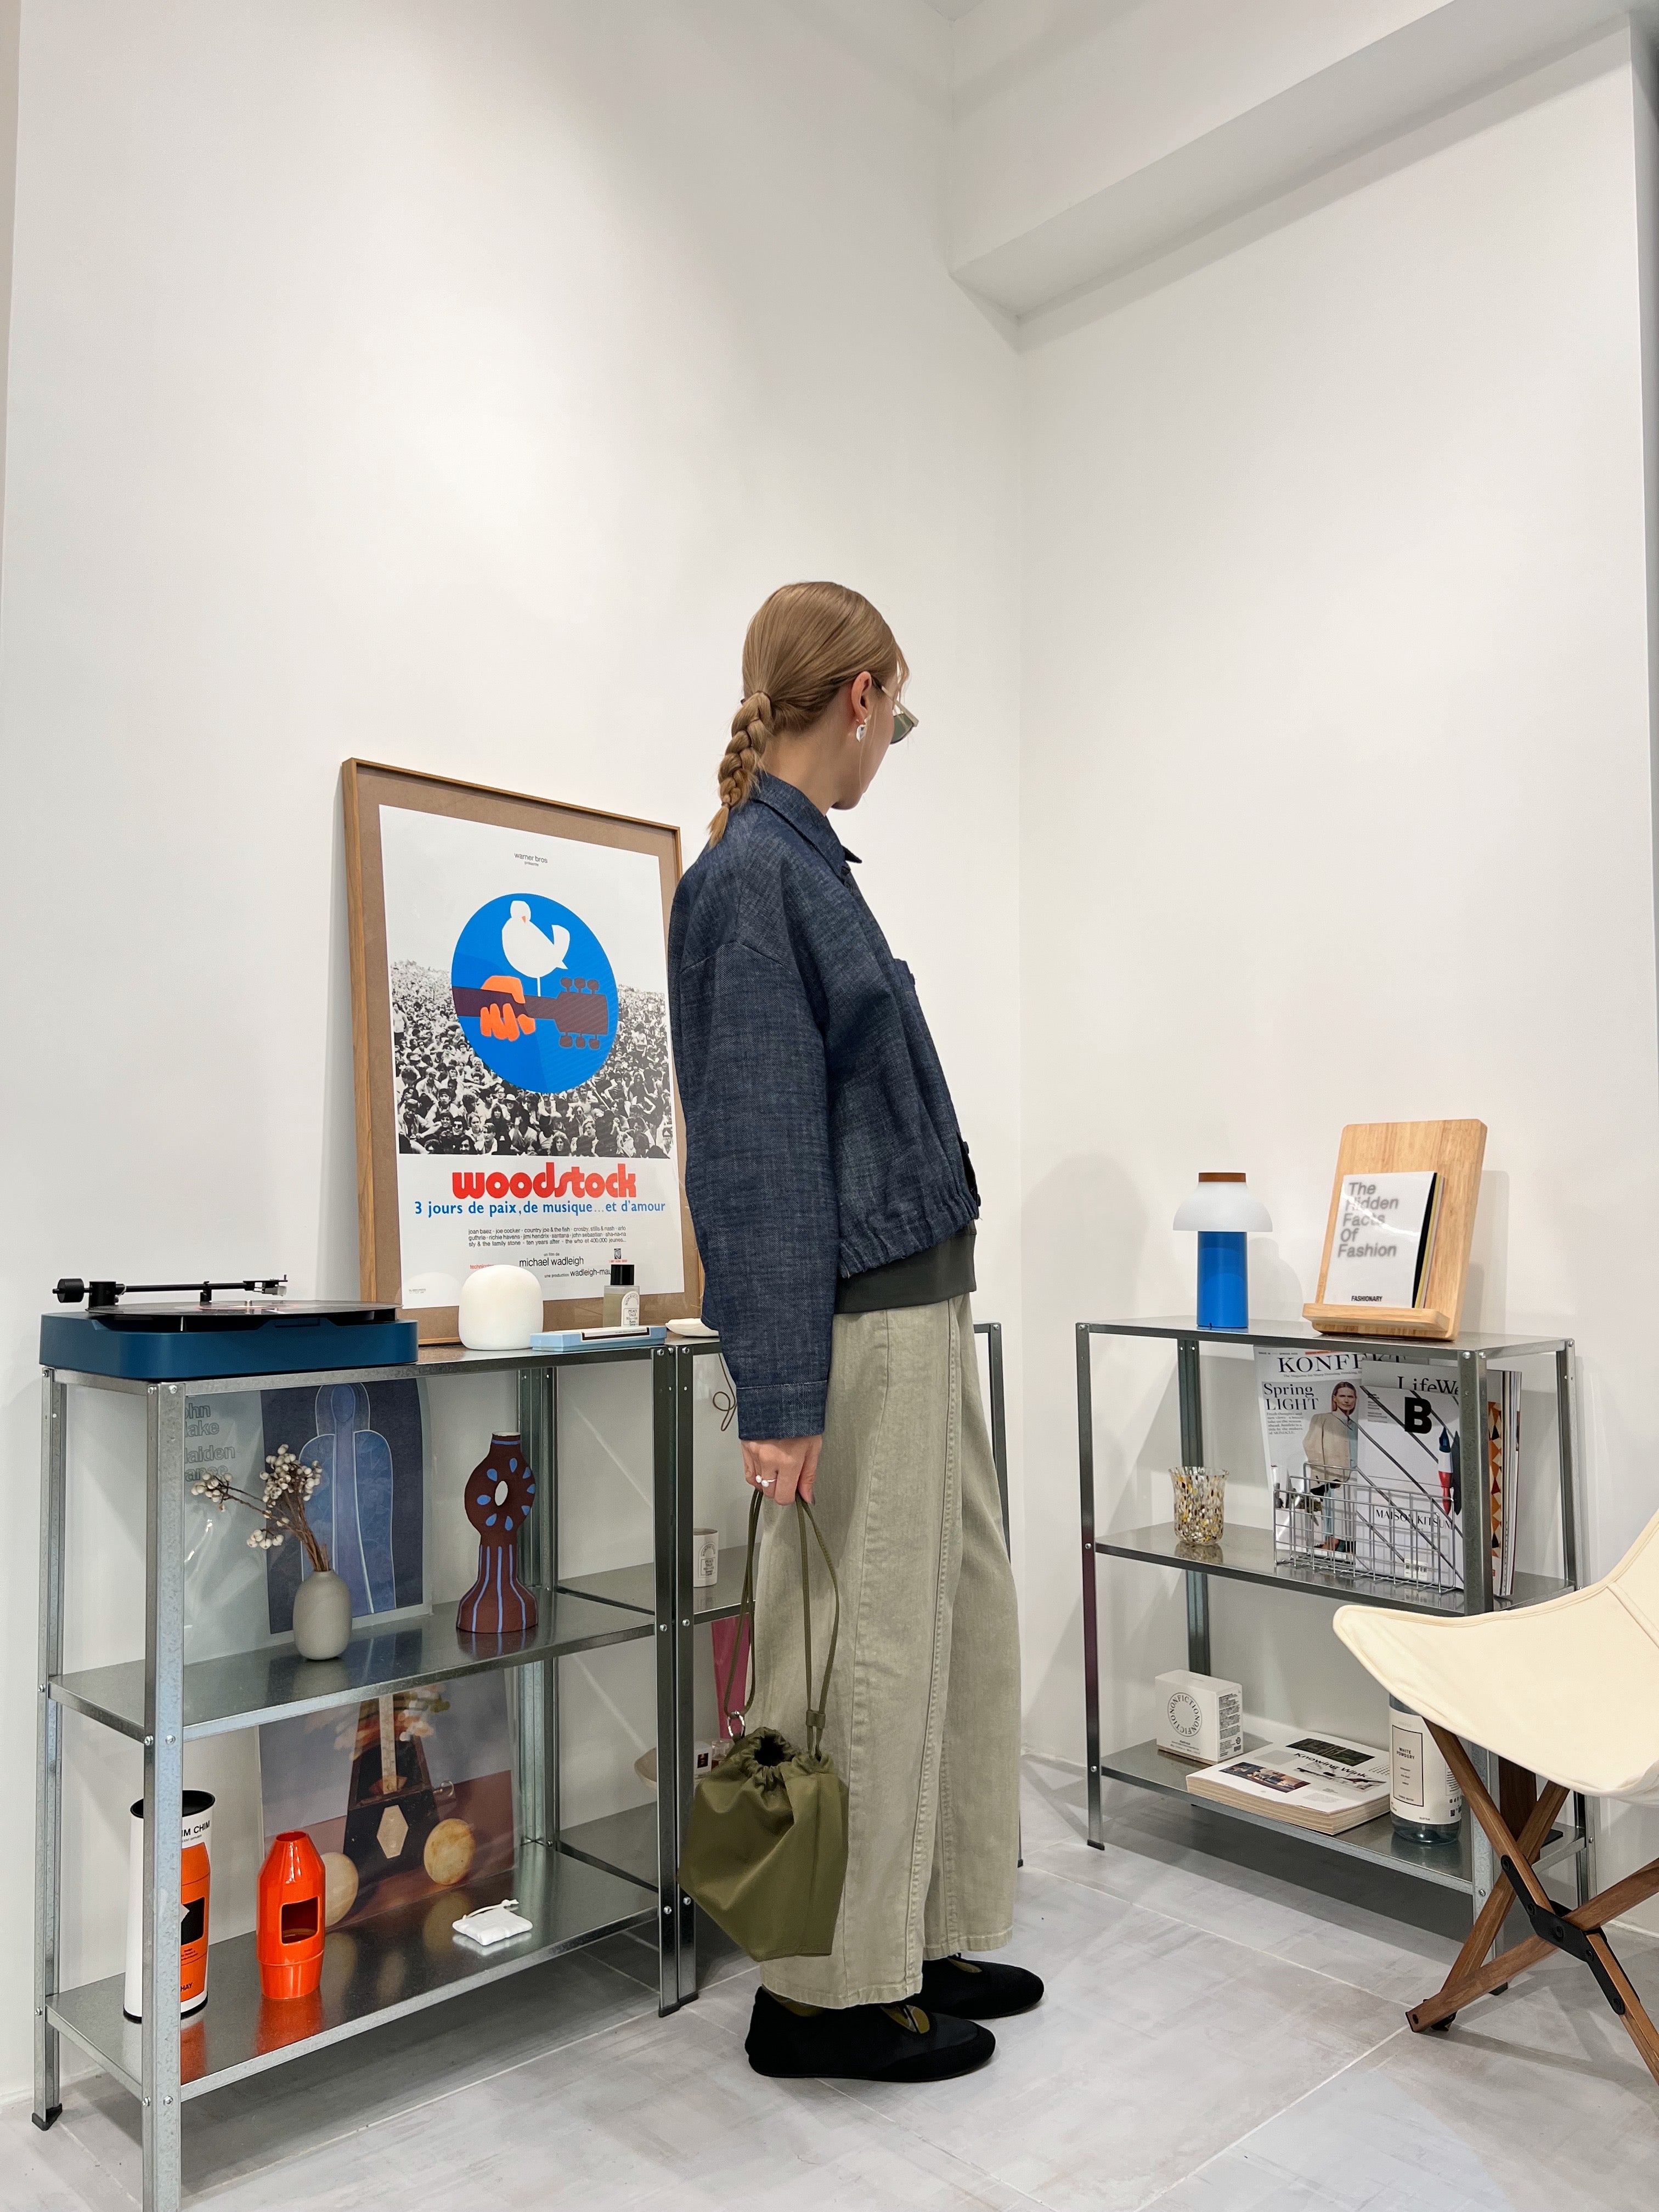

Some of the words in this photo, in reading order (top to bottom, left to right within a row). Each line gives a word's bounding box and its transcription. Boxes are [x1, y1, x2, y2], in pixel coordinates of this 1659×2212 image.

[514, 853, 534, 861] warner
[535, 855, 548, 864] bros
[452, 1162, 636, 1199] woodstock
[1349, 1182, 1376, 1195] The
[415, 1201, 422, 1214] 3
[428, 1201, 463, 1218] jours
[468, 1201, 484, 1214] de
[523, 1200, 538, 1214] de
[621, 1200, 665, 1212] d'amour
[1340, 1228, 1360, 1242] Of
[1338, 1243, 1397, 1258] Fashion
[519, 1257, 549, 1267] michael
[551, 1256, 584, 1266] wadleigh
[1263, 1383, 1314, 1398] Spring
[185, 1403, 211, 1419] ohn
[1266, 1398, 1319, 1410] LIGHT
[1404, 1397, 1432, 1434] B
[185, 1420, 219, 1438] lake
[185, 1445, 235, 1464] aiden
[1376, 1509, 1413, 1523] MAISON
[1418, 1515, 1453, 1530] KITSUN
[1294, 1752, 1339, 1770] Knowing
[1341, 1767, 1368, 1778] Wink
[182, 1828, 191, 1837] IM
[180, 1982, 193, 1992] HAY
